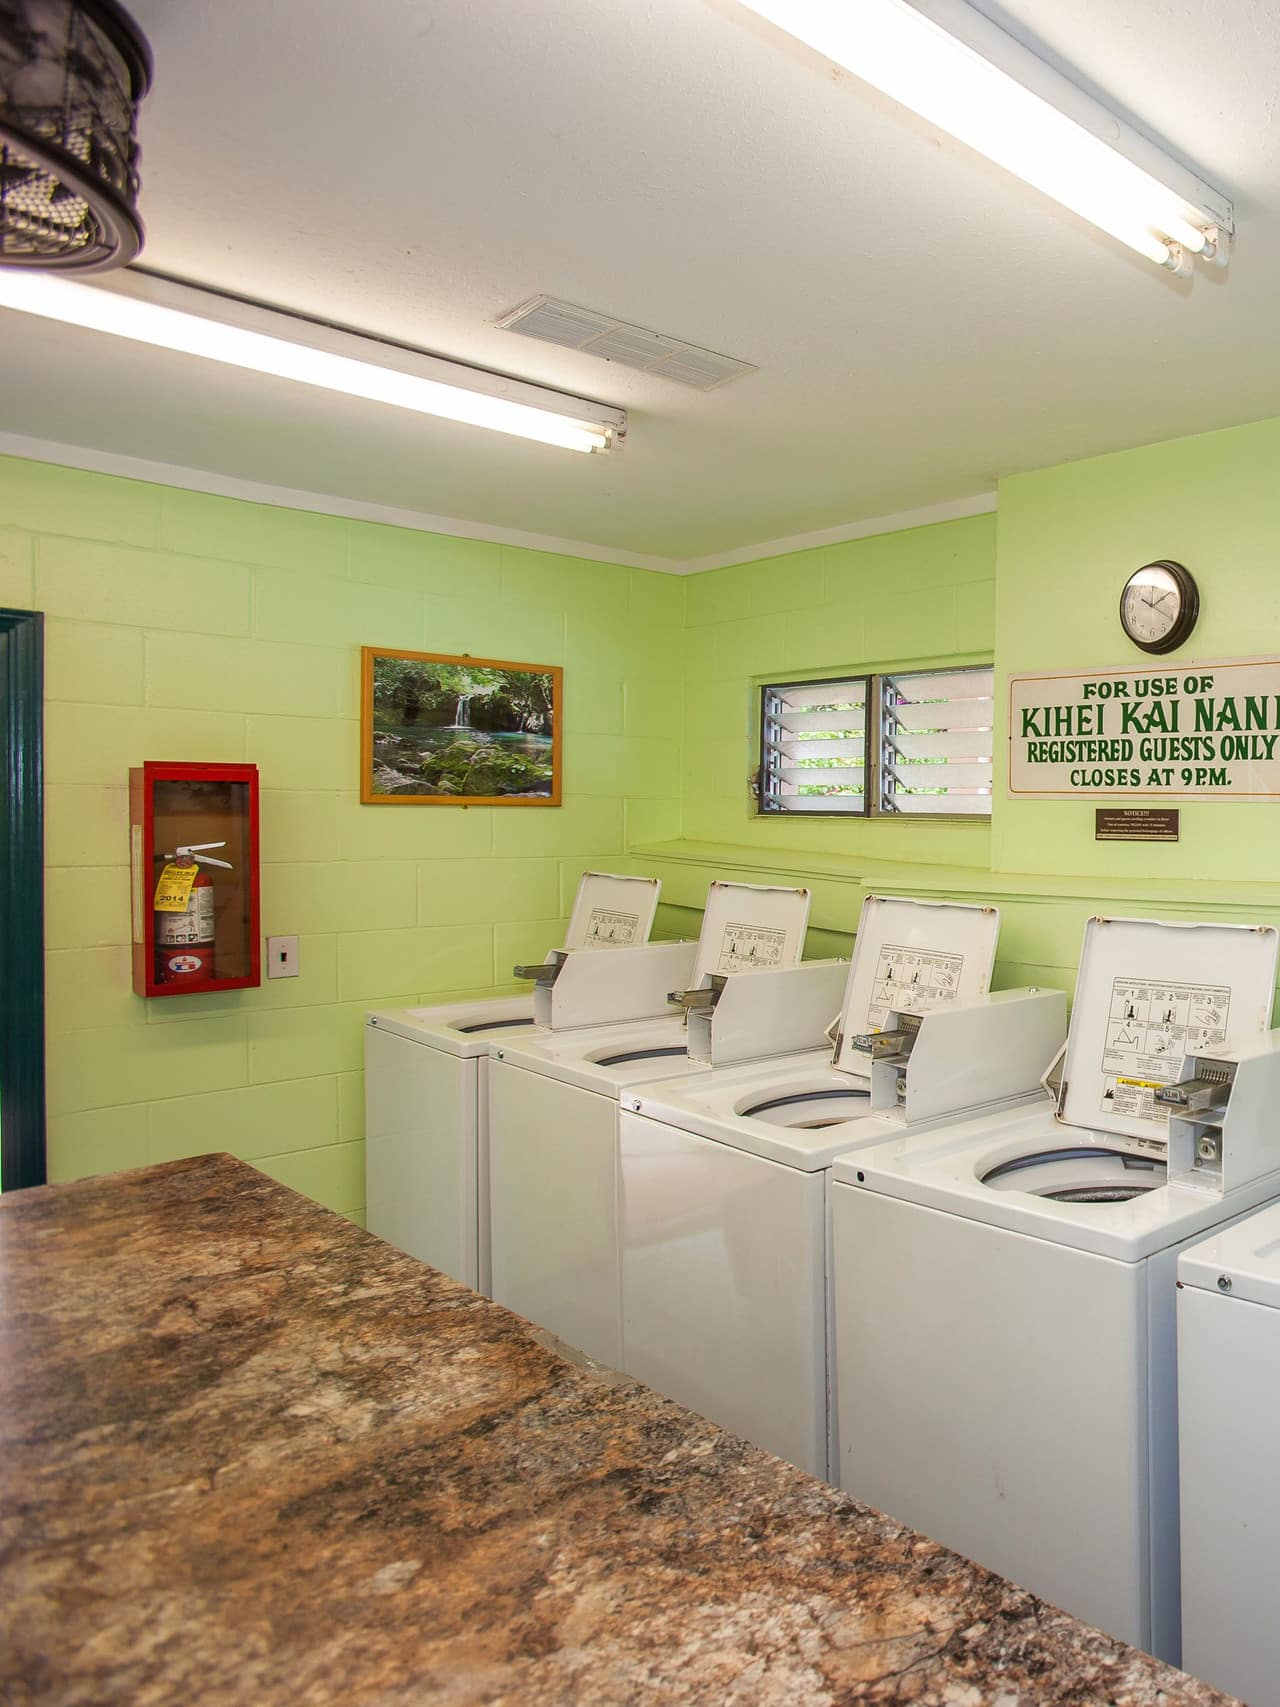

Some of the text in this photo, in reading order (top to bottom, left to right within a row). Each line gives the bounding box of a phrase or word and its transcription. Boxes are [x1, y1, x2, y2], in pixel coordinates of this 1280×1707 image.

[1131, 616, 1137, 625] 8
[1083, 675, 1215, 700] FOR USE OF
[1020, 703, 1105, 738] KIHEI
[1120, 699, 1181, 735] KAI
[1026, 734, 1280, 763] REGISTERED GUESTS ONLY
[1070, 768, 1141, 787] CLOSES
[1146, 768, 1175, 786] AT
